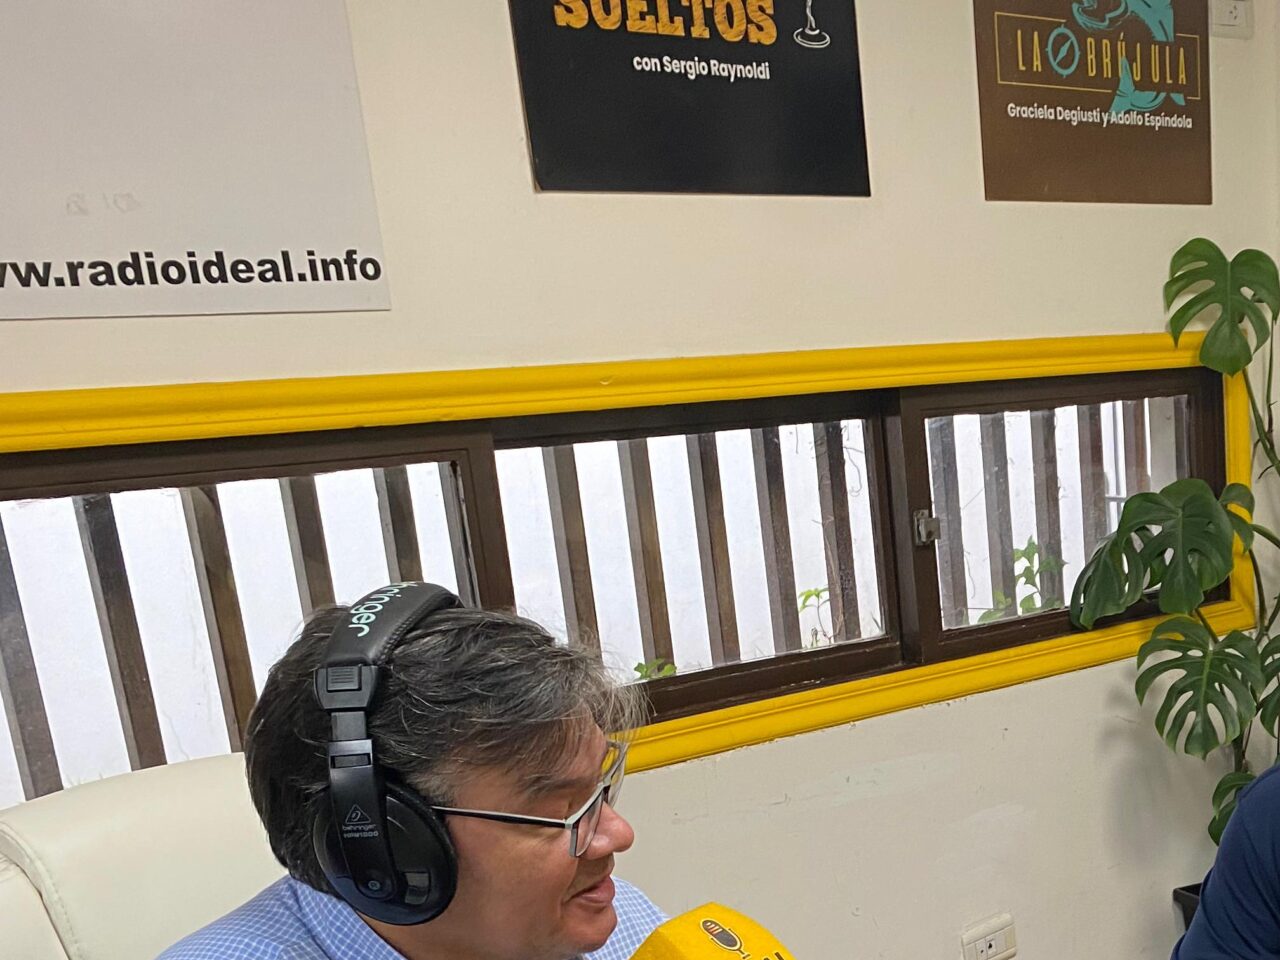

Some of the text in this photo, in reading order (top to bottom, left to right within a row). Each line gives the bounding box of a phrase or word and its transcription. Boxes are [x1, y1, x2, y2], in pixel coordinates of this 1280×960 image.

[1016, 29, 1042, 73] LA
[633, 54, 770, 82] con Sergio Raynoldi
[1007, 103, 1055, 120] Graciela
[1057, 106, 1101, 126] Degiusti
[1100, 113, 1110, 127] y
[1110, 110, 1143, 126] Adolfo
[0, 249, 383, 288] w.radioideal.info
